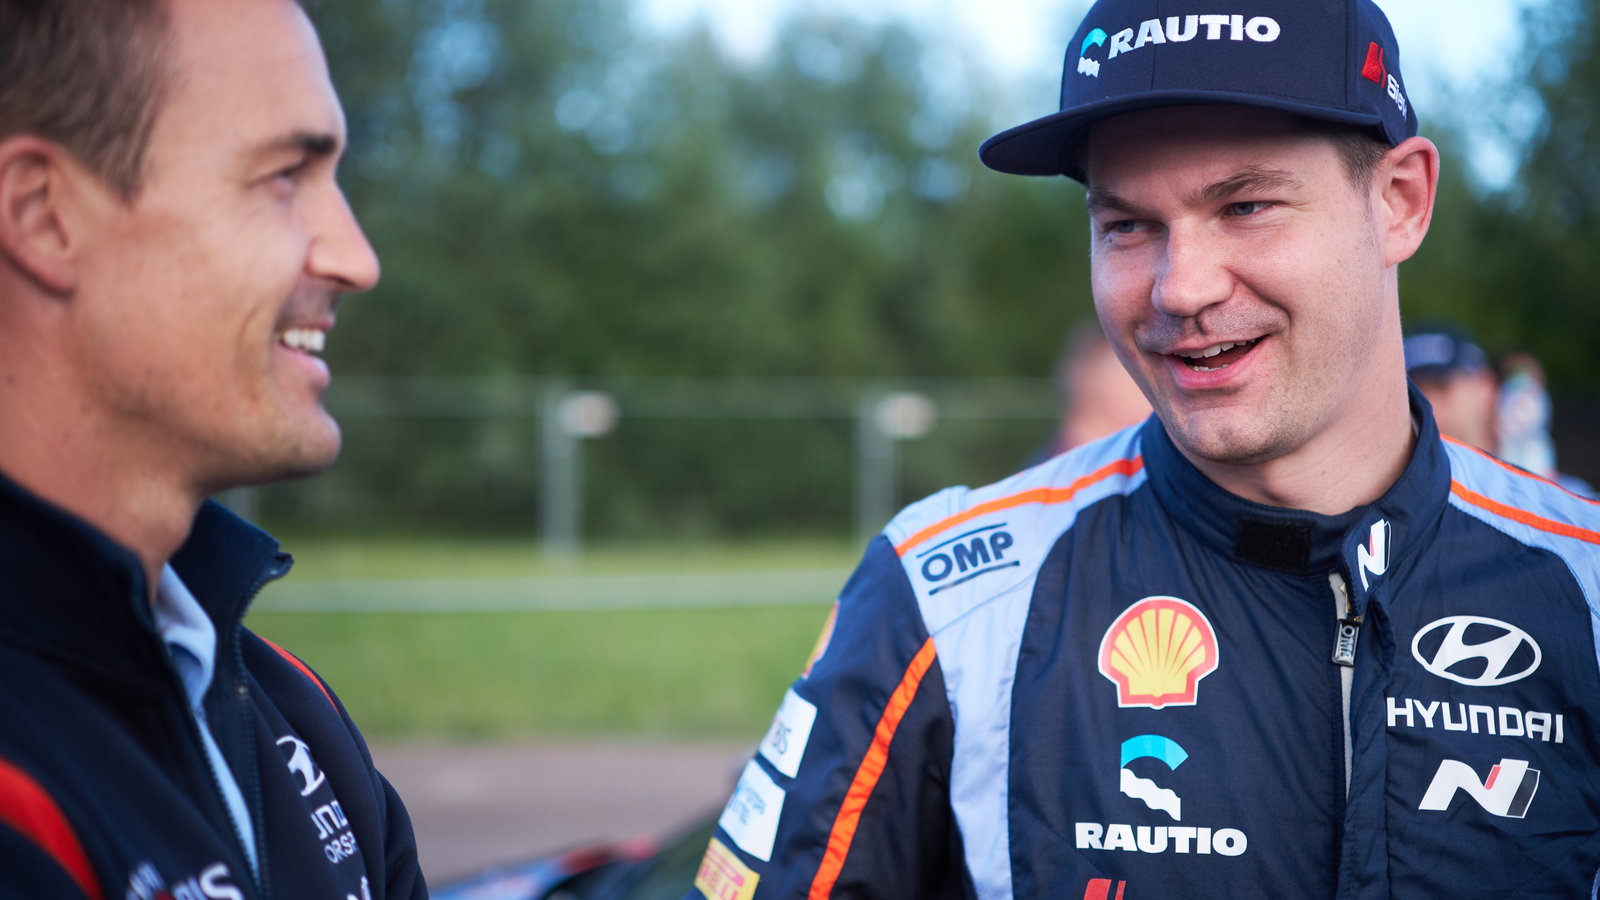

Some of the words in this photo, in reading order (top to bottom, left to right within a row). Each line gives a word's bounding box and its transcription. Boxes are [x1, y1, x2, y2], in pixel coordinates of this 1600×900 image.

[1108, 14, 1281, 59] RAUTIO
[921, 531, 1013, 582] OMP
[1386, 697, 1564, 743] HYUNDAI
[1075, 822, 1247, 857] RAUTIO
